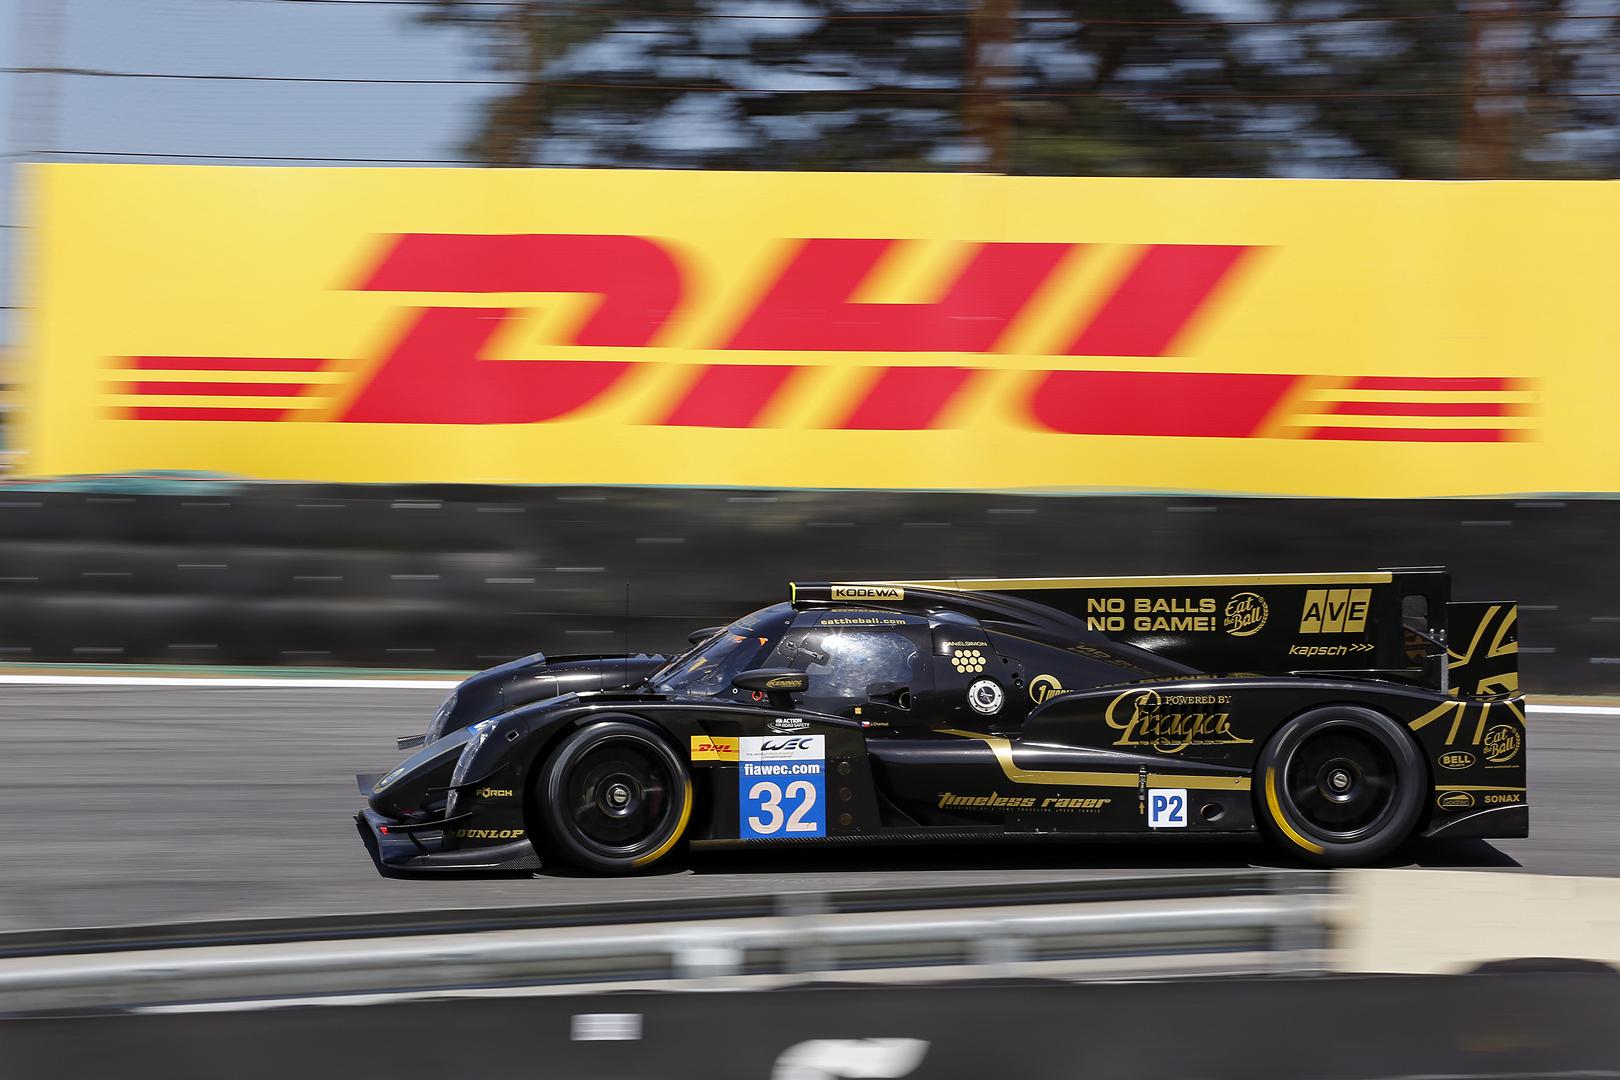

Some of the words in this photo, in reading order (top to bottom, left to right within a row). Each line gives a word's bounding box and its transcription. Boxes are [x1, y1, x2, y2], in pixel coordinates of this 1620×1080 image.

[335, 232, 1290, 438] DHL
[836, 589, 899, 597] KODEWA
[1088, 599, 1125, 612] NO
[1134, 599, 1216, 612] BALLS
[1225, 597, 1254, 616] Eat
[1303, 602, 1367, 622] AVE
[1088, 617, 1125, 631] NO
[1134, 617, 1216, 631] GAME!
[1226, 607, 1262, 633] Ball
[1289, 645, 1348, 657] kapsch
[1165, 696, 1216, 705] POWERED
[1218, 696, 1232, 704] BY
[1484, 728, 1508, 746] Eat
[698, 744, 733, 752] DHL
[761, 738, 814, 751] WEC
[1443, 755, 1471, 764] BELL
[744, 764, 820, 776] fiawec.com
[1041, 798, 1111, 808] racer
[1484, 794, 1520, 803] SONAX
[748, 781, 817, 834] 32
[1153, 795, 1183, 822] P2
[456, 829, 524, 838] DUNLOP
